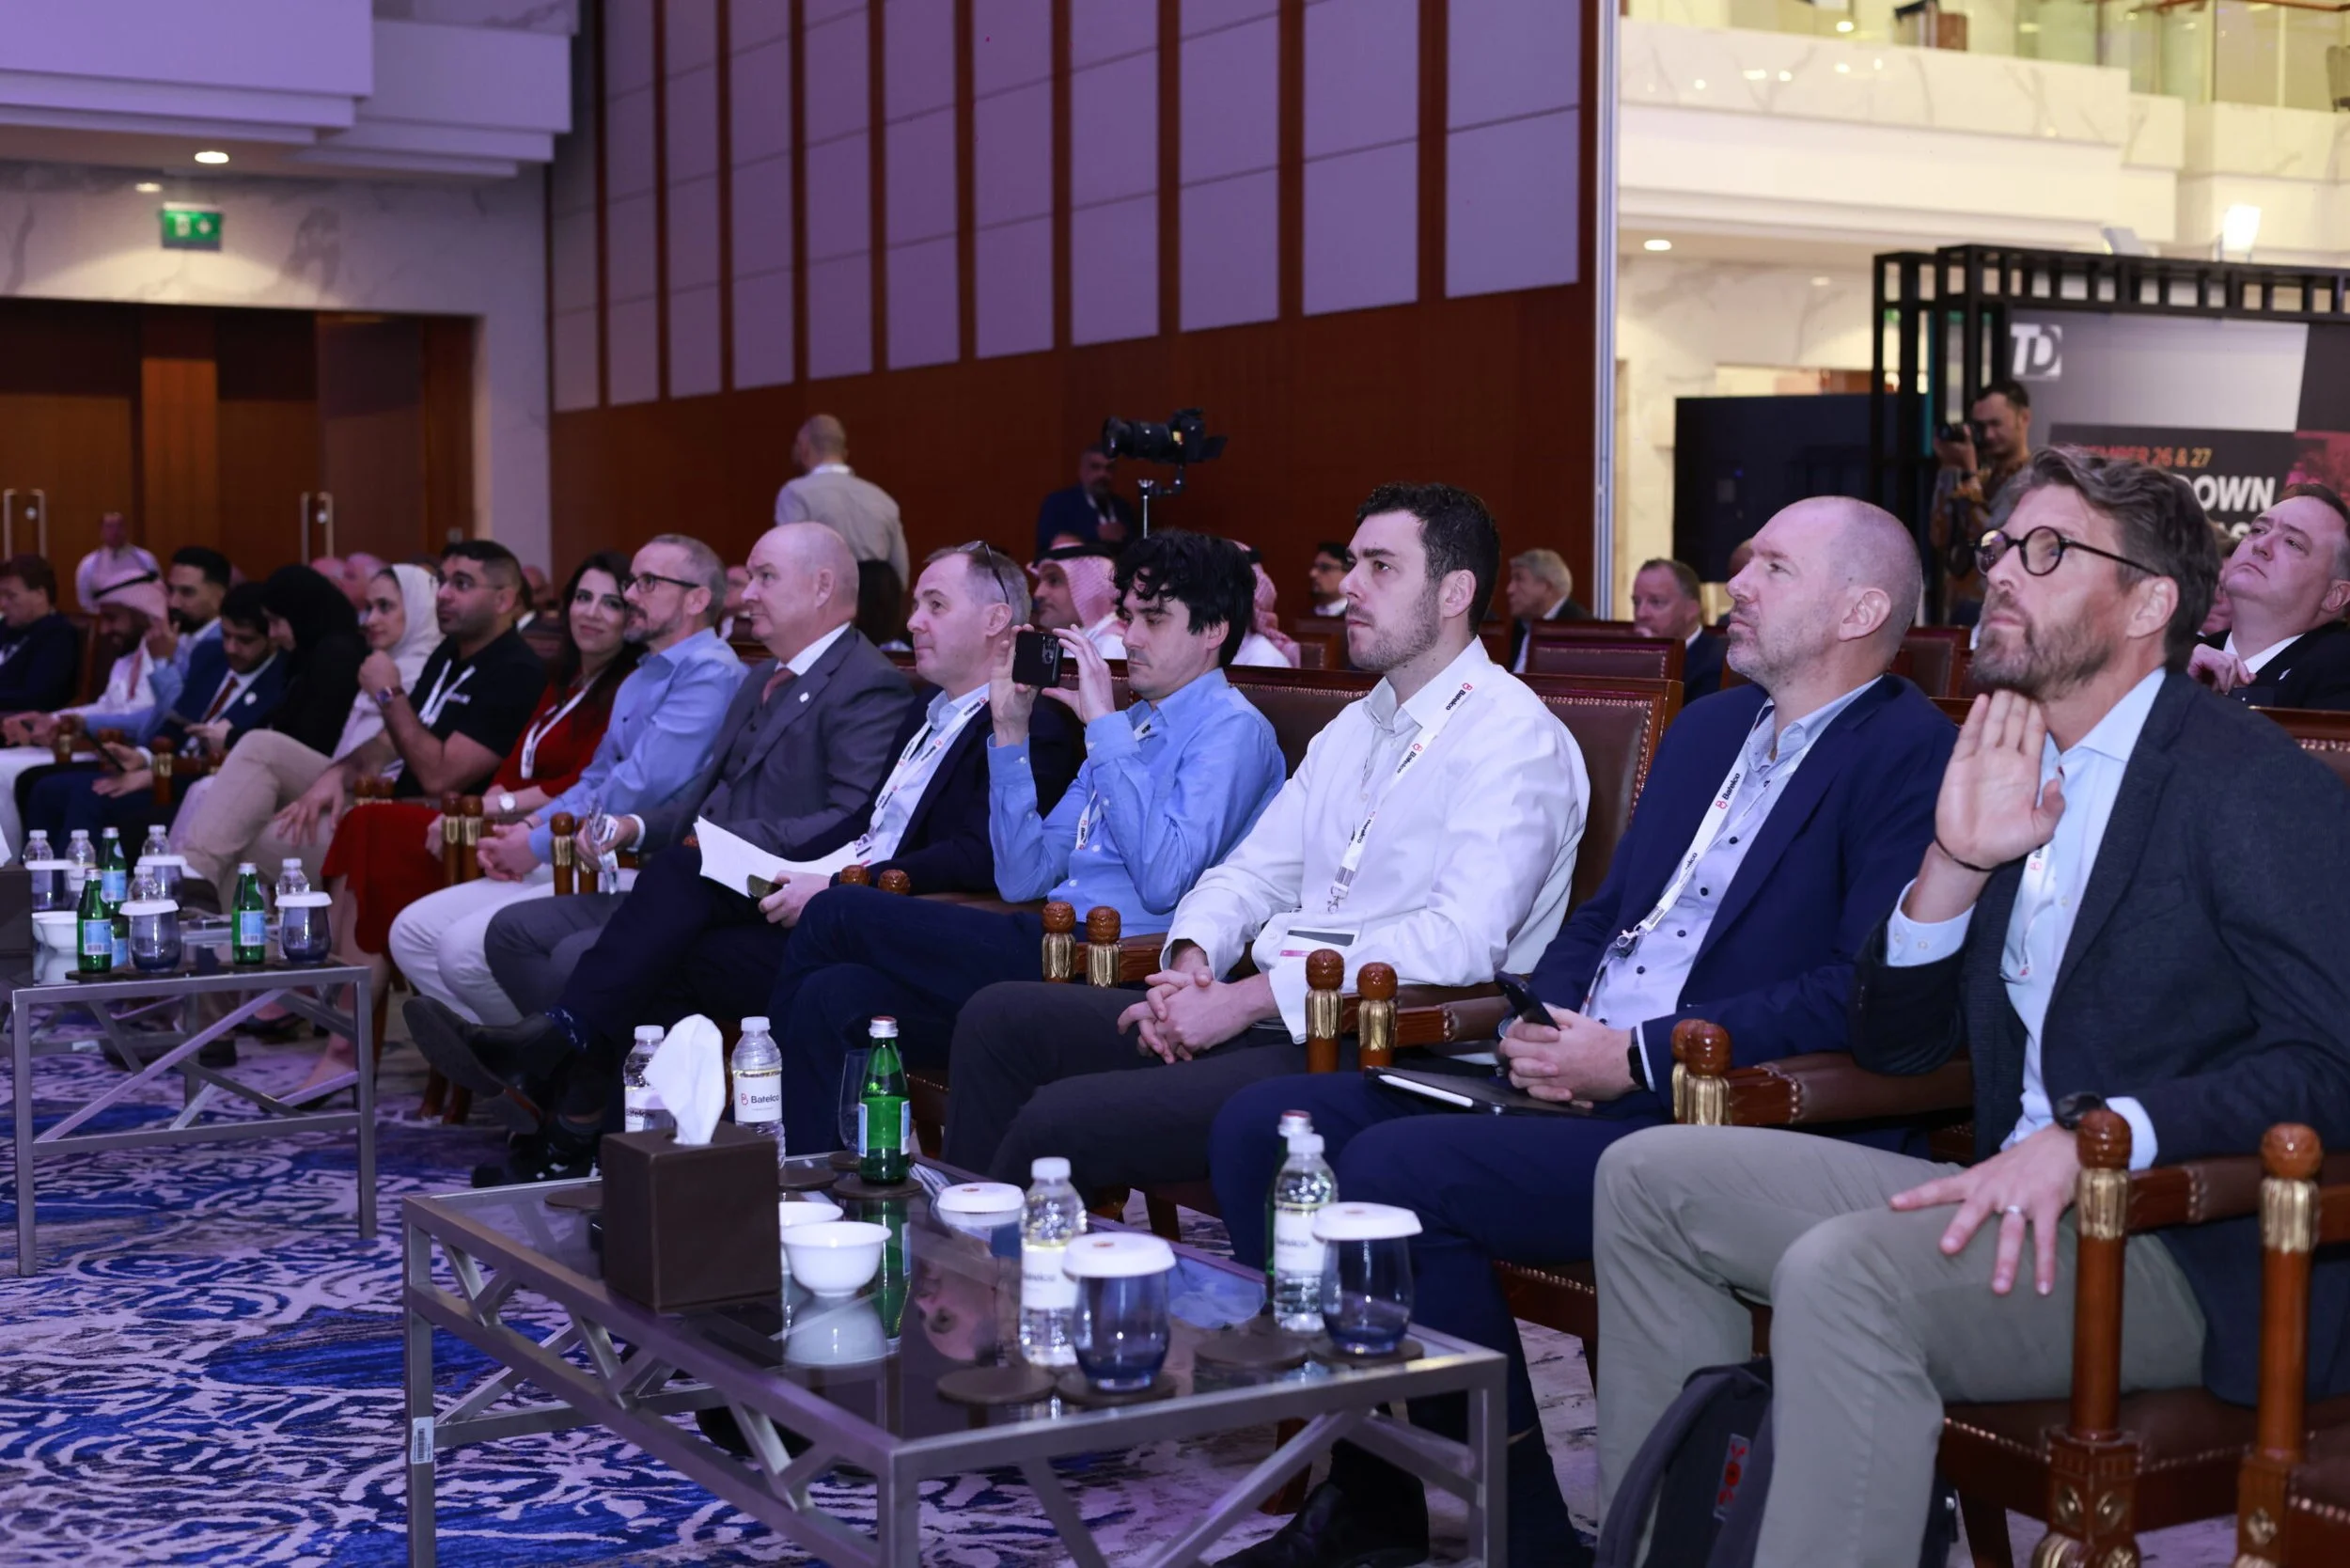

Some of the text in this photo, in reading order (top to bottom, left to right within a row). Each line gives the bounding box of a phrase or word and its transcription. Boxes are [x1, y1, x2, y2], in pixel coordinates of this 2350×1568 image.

[2152, 447, 2173, 467] 26
[2190, 447, 2213, 467] 27
[2175, 473, 2276, 513] OWN
[1446, 689, 1466, 711] Batelco
[1397, 751, 1417, 774] Batelco
[1722, 773, 1741, 801] Batelco
[750, 1094, 780, 1105] Batelco
